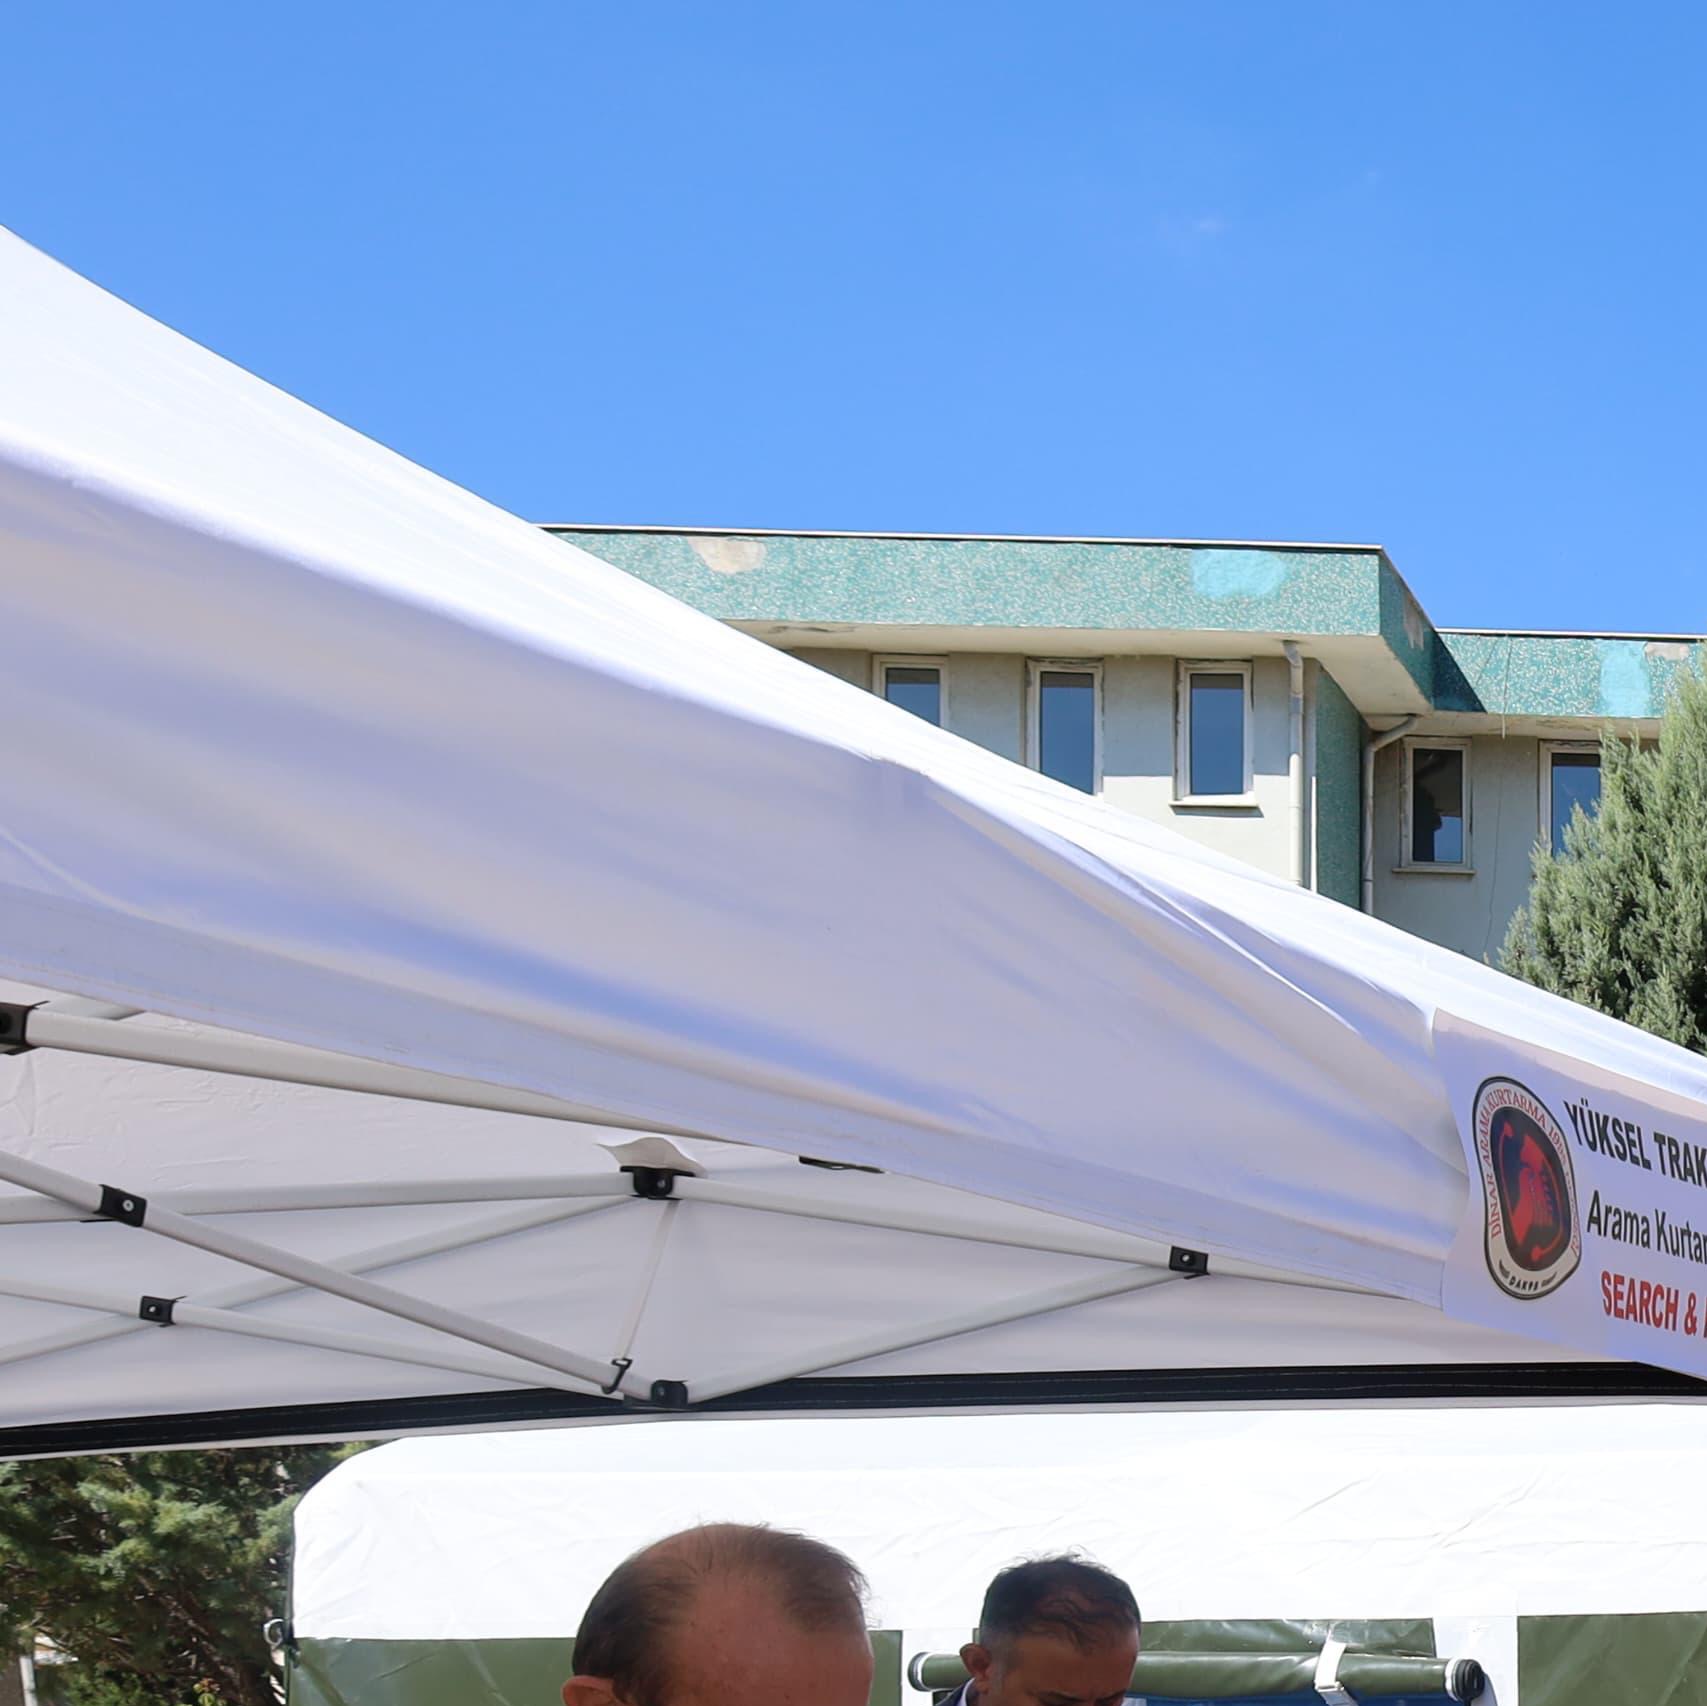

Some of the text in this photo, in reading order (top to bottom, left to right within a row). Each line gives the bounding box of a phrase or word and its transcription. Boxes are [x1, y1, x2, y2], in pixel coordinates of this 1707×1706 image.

[1486, 1087, 1547, 1130] KURTARMA
[1563, 1098, 1651, 1171] YÜKSEL
[1586, 1189, 1650, 1250] Arama
[1600, 1270, 1678, 1332] SEARCH
[1683, 1292, 1698, 1336] &
